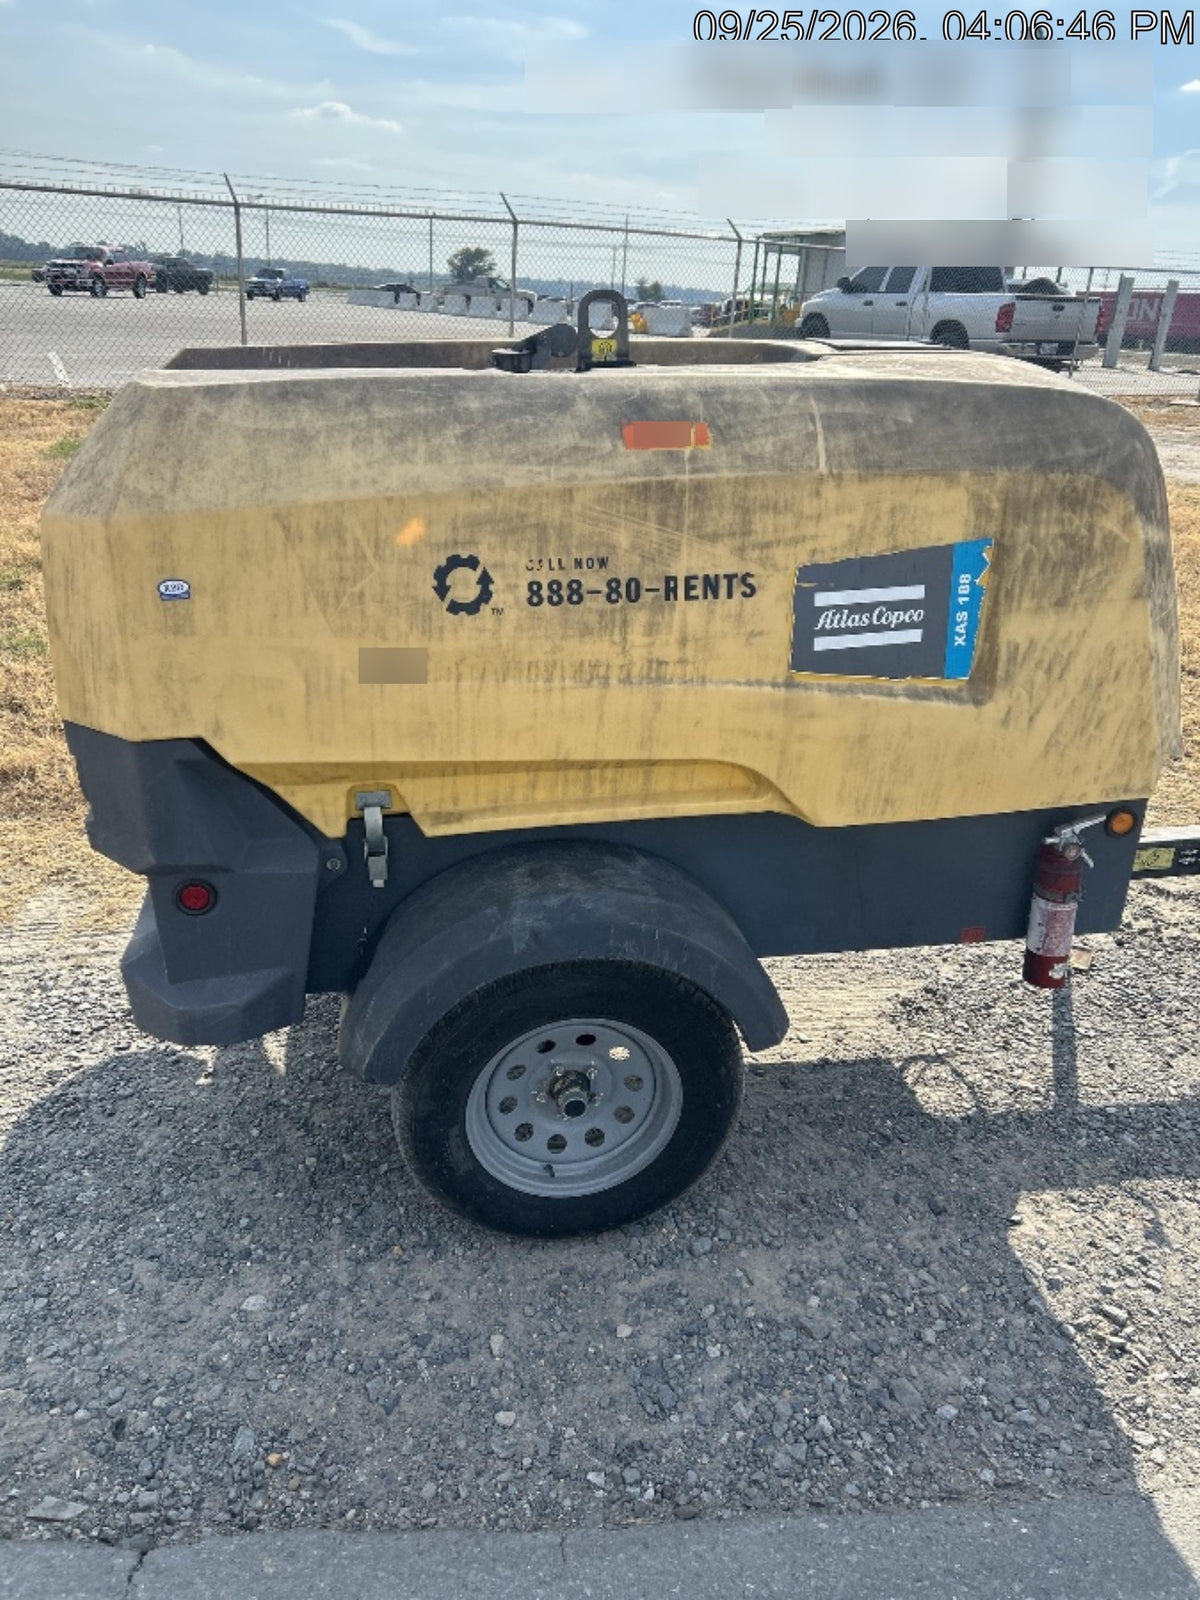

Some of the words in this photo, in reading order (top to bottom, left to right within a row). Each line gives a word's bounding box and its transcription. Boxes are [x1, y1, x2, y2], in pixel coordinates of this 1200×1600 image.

[573, 556, 608, 570] NOW
[526, 572, 757, 607] 888-80-RENTS
[958, 573, 971, 605] 188
[813, 608, 870, 630] Atlas
[871, 605, 925, 628] Copco
[954, 611, 969, 647] XAS
